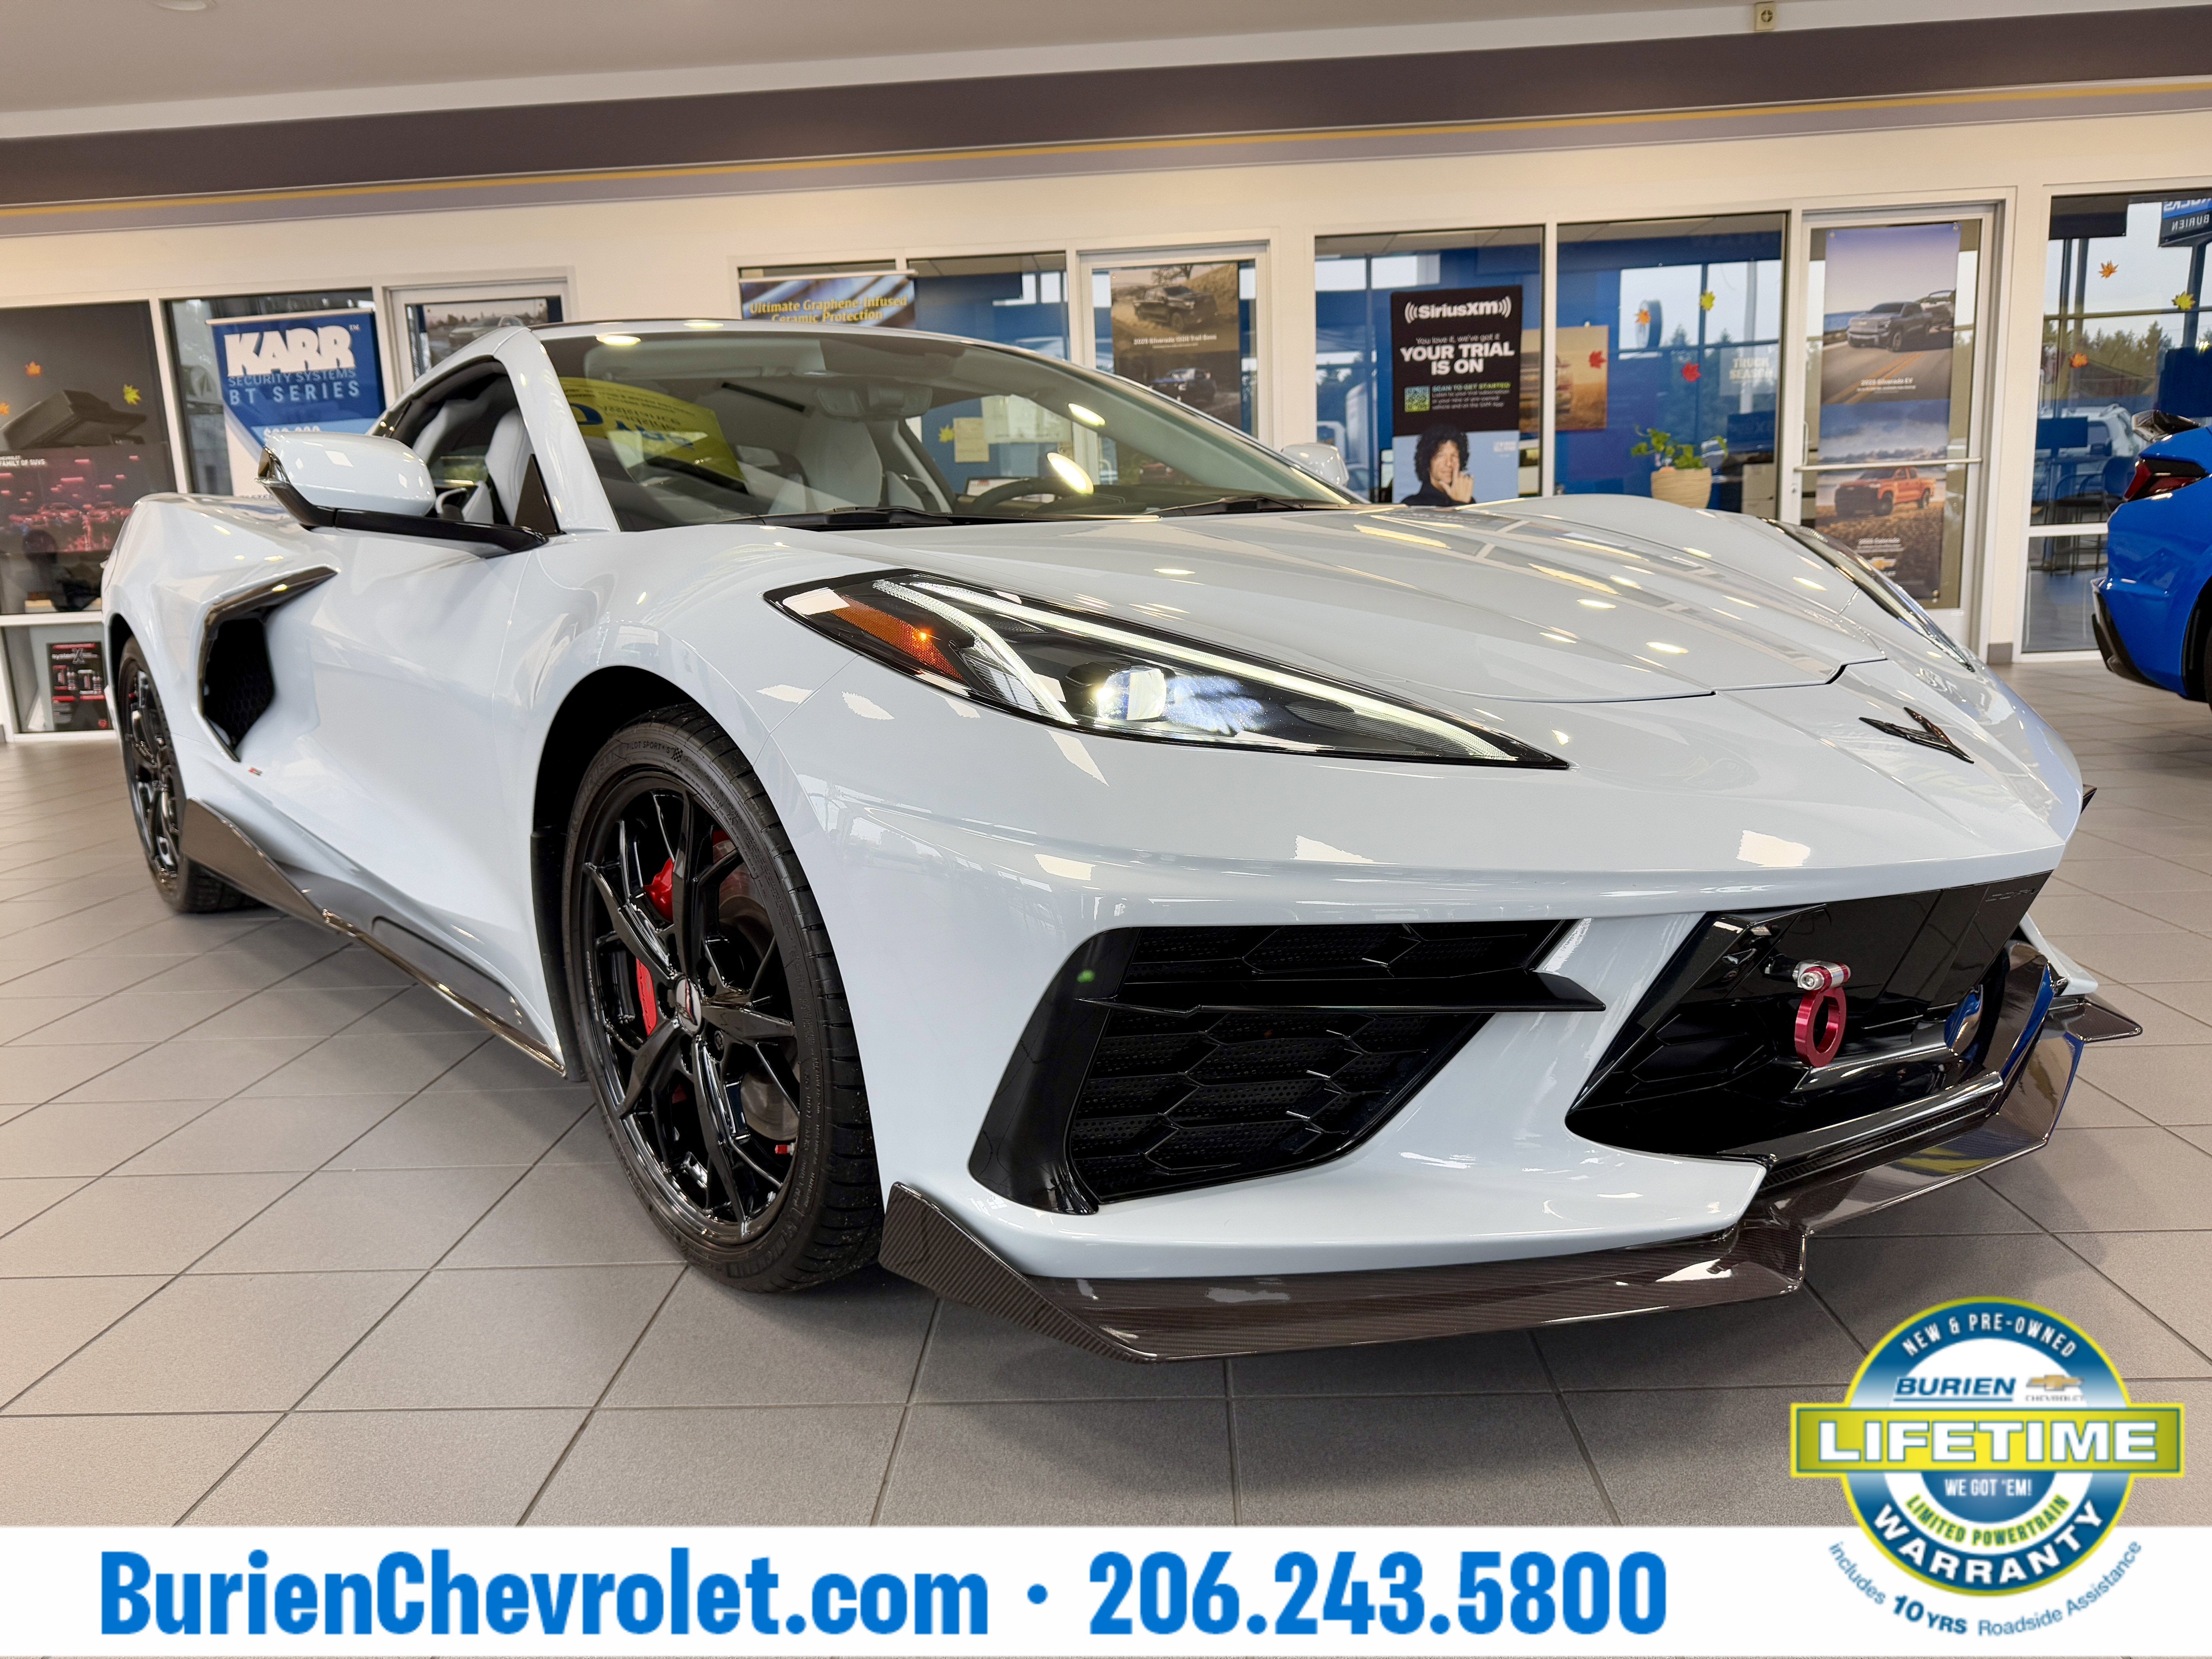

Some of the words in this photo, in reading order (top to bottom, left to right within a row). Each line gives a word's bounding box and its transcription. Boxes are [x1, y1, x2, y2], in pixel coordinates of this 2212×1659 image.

[750, 301, 800, 314] Ultimate
[772, 313, 818, 323] Ceramic
[823, 309, 883, 322] Protection
[224, 326, 355, 376] KARR
[1400, 344, 1455, 362] YOUR
[1458, 341, 1515, 358] TRIAL
[1431, 360, 1451, 375] IS
[1454, 357, 1484, 374] ON
[228, 373, 291, 388] SECURITY
[296, 369, 356, 383] SYSTEMS
[229, 388, 256, 405] BT
[273, 380, 360, 403] SERIES
[626, 741, 641, 750] PILOT
[643, 740, 662, 750] SPORT
